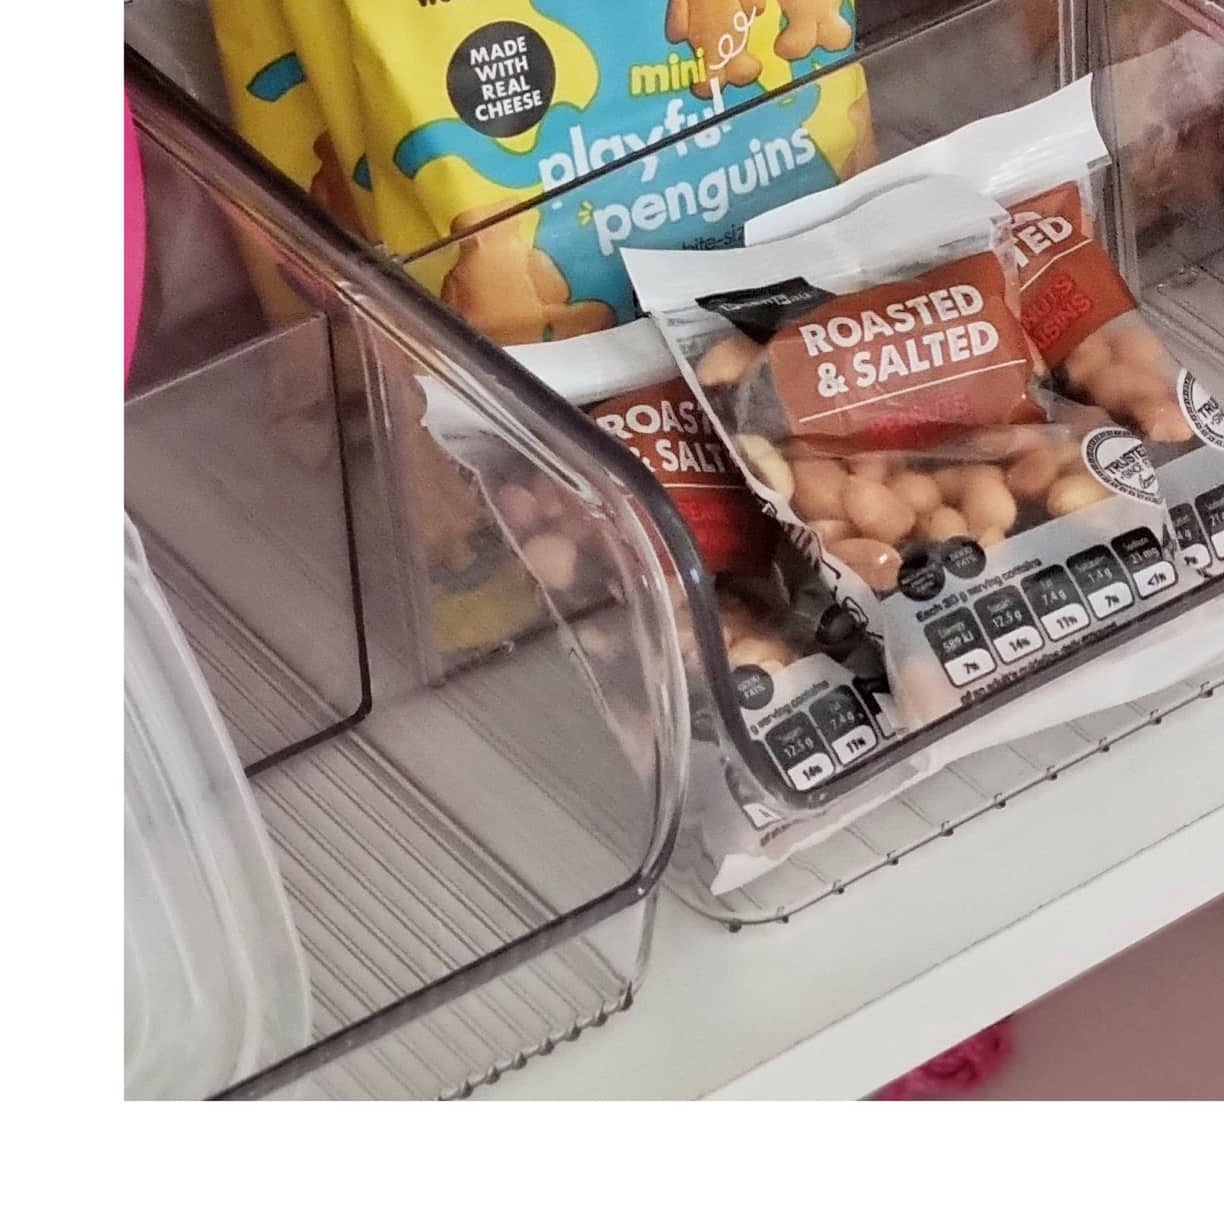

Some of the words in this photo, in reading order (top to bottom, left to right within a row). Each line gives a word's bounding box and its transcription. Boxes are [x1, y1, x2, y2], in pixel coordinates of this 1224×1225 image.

[469, 35, 528, 66] MADE
[475, 55, 529, 83] WITH
[629, 48, 707, 97] mini
[481, 75, 531, 102] REAL
[474, 89, 543, 122] CHEESE
[538, 77, 732, 210] playful
[593, 126, 816, 256] penguins
[798, 283, 984, 358] ROASTED
[816, 363, 848, 399] &
[853, 320, 1000, 391] SALTED
[1104, 594, 1121, 609] 7%
[962, 661, 980, 675] 7%
